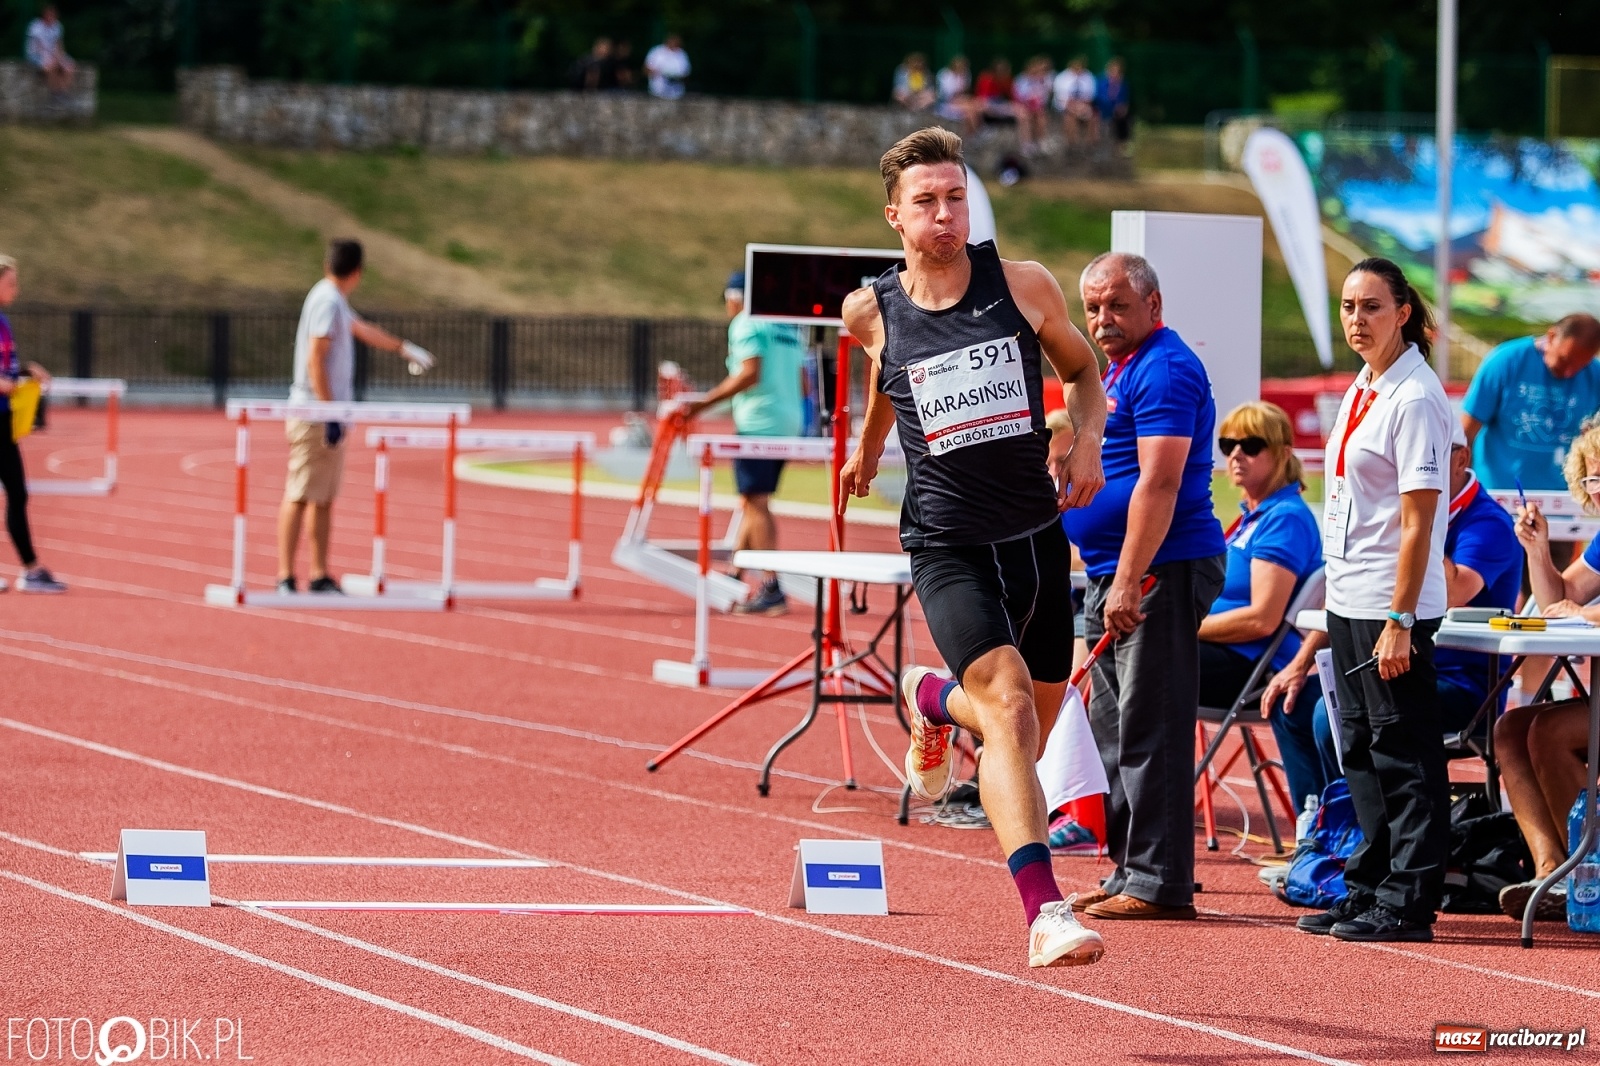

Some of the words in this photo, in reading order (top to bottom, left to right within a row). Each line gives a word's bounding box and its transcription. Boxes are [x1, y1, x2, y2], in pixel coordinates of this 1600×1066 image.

[928, 364, 960, 377] Racibórz
[969, 341, 1016, 371] 591
[920, 379, 1024, 421] KARASIŃSKI
[939, 427, 995, 451] RACIBÓRZ
[997, 422, 1021, 436] 2019
[956, 417, 994, 431] MISTRZOSTWA
[993, 413, 1012, 422] POLSKI
